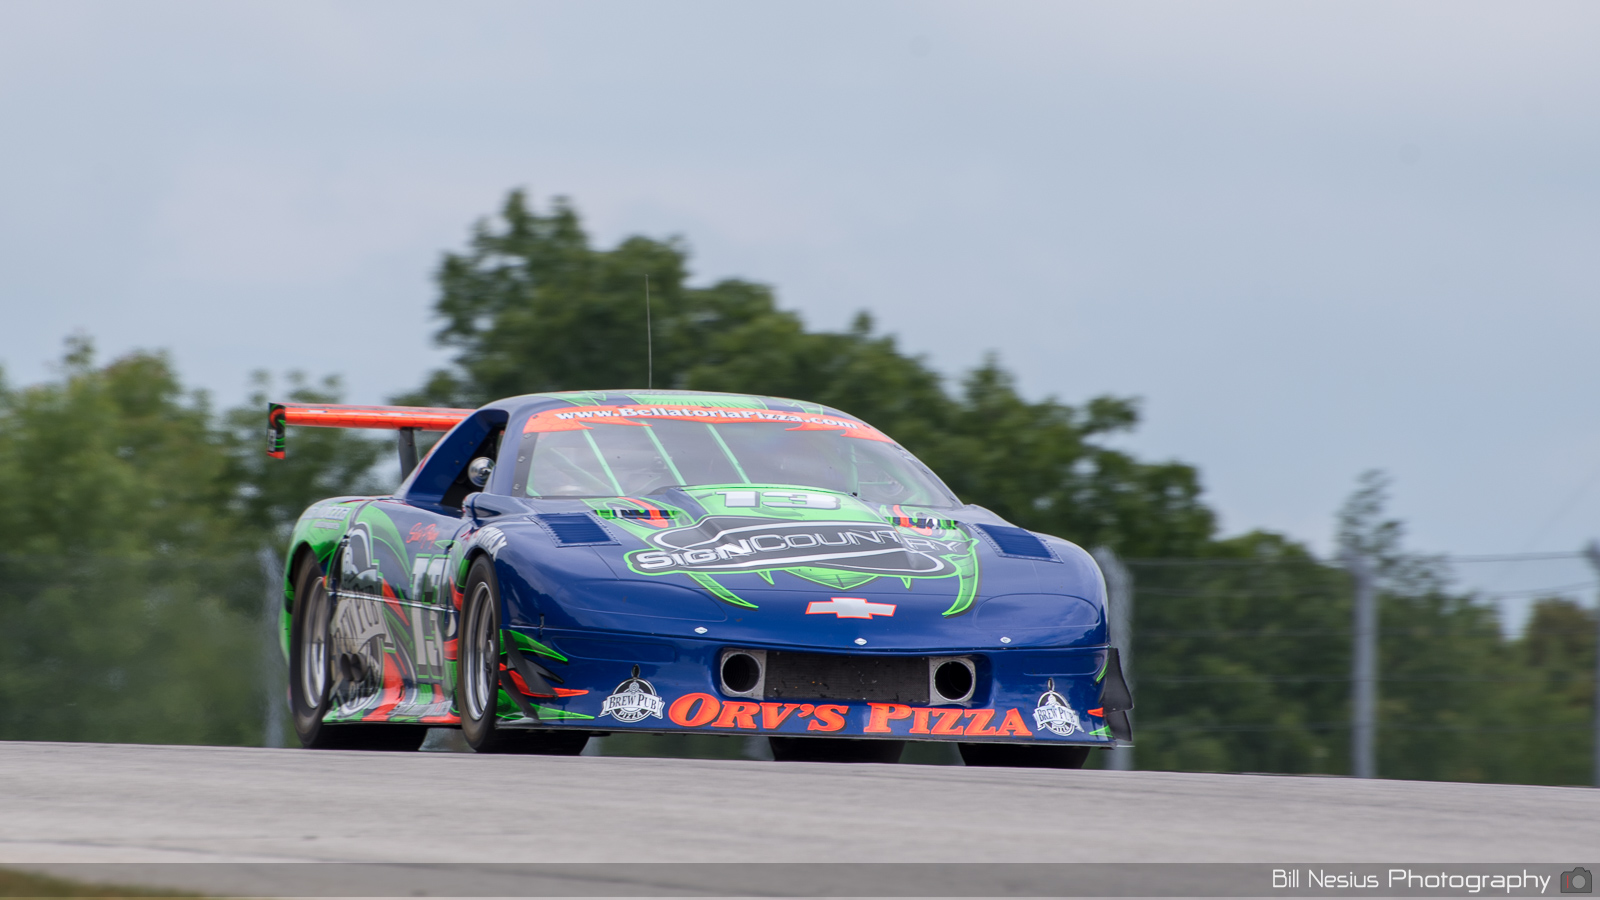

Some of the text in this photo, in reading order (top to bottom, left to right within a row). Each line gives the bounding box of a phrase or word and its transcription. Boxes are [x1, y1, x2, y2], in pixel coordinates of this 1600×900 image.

[554, 406, 859, 430] www.BellatoriaPizza.com
[715, 490, 841, 510] 13
[608, 693, 658, 710] BREW PUB
[617, 710, 643, 720] PIZZA
[668, 692, 1033, 736] ORV'S PIZZA
[1036, 708, 1058, 721] BREW
